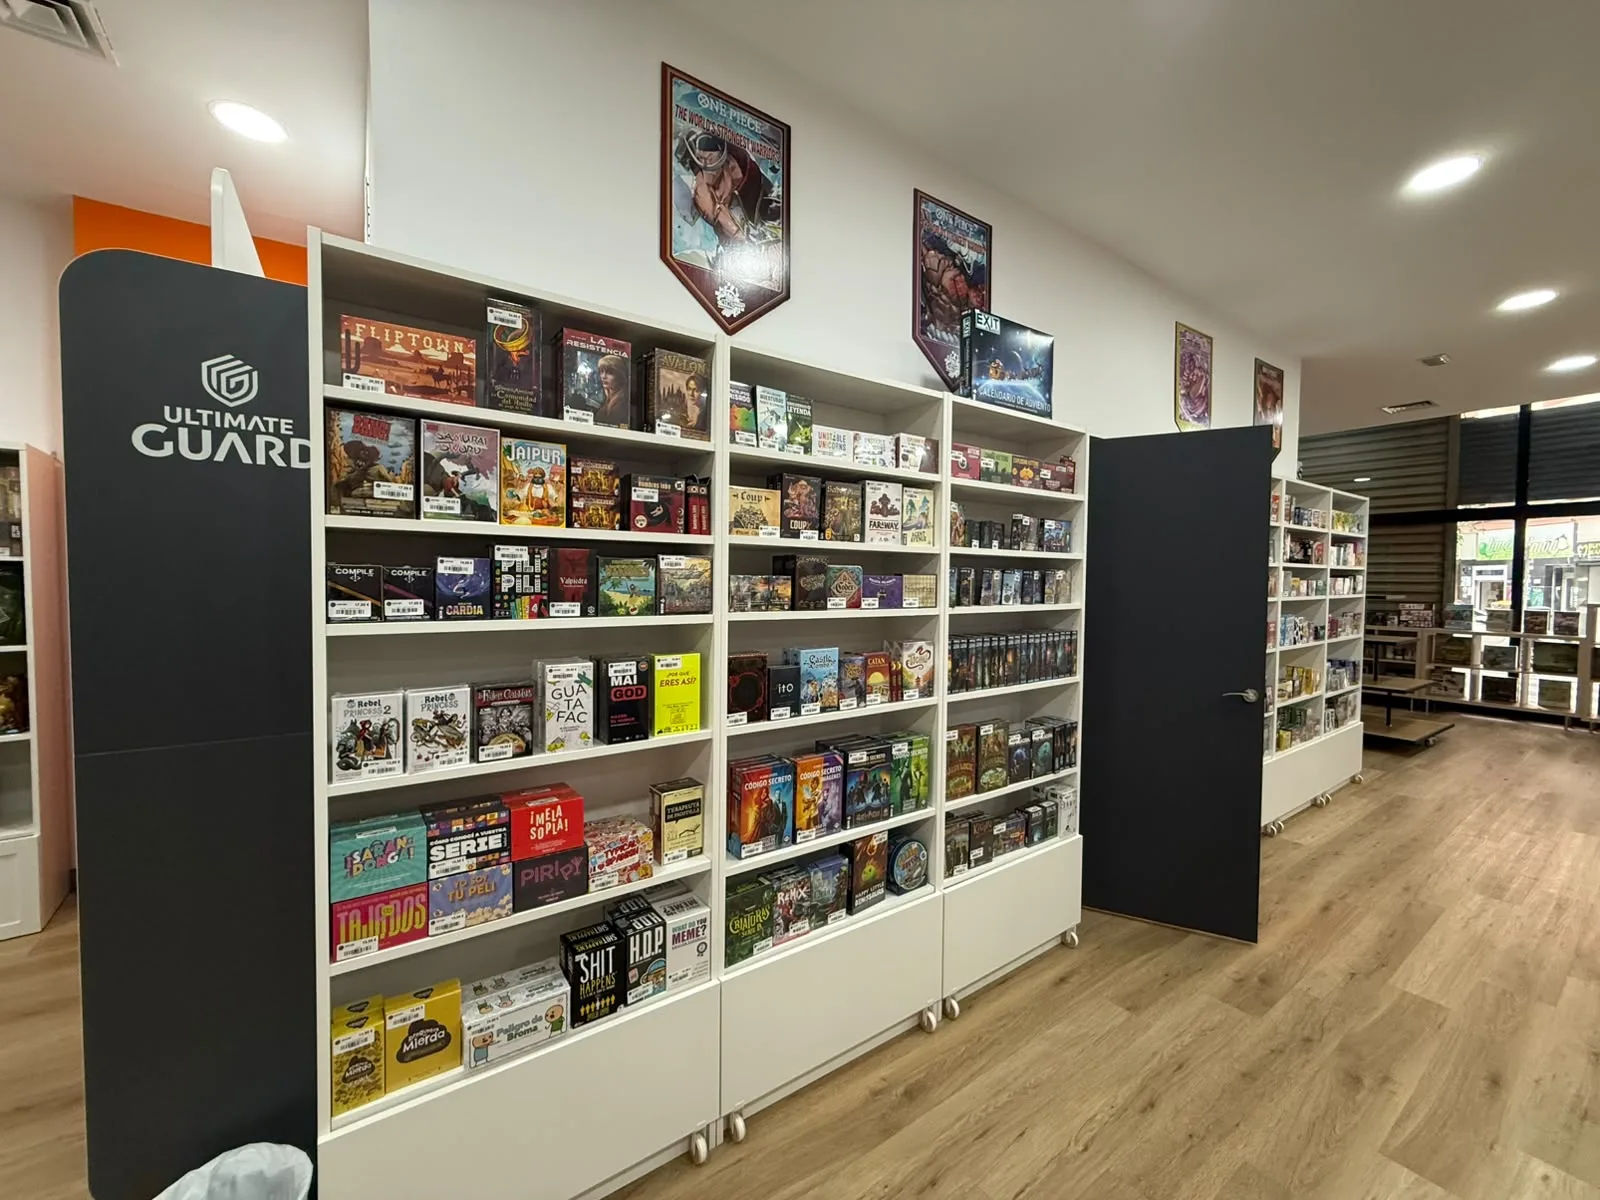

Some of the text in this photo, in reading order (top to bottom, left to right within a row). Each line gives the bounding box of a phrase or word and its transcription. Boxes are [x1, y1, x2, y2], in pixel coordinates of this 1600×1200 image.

[697, 93, 761, 133] ONE PIECE
[675, 104, 687, 121] THE
[717, 123, 748, 149] STRONGEST
[976, 313, 999, 330] EXIT
[355, 323, 464, 353] FLIPTOWN
[590, 336, 606, 346] LA
[566, 339, 629, 358] RESISTENCIA
[662, 354, 706, 374] AVALON
[980, 386, 1015, 403] CALENDARIO
[1016, 396, 1025, 404] DE
[1025, 397, 1051, 413] ADVIENTO
[164, 405, 294, 436] ULTIMATE
[436, 432, 488, 446] SAMURAI
[818, 431, 846, 442] UNSTABLE
[131, 423, 311, 469] GUARD
[507, 443, 562, 466] JAIPUR
[741, 491, 763, 502] Coup
[335, 568, 375, 576] COMPILE
[391, 569, 427, 577] COMPILE
[502, 574, 541, 592] PILI
[446, 605, 484, 615] CARDIA
[531, 603, 538, 613] 4
[868, 657, 885, 665] CATAN
[610, 674, 637, 687] MAI
[660, 678, 681, 688] ERES
[424, 694, 448, 703] Rebel
[551, 684, 587, 700] GUA
[613, 687, 645, 699] GOD
[343, 705, 391, 718] PRINCESS 2
[357, 699, 381, 708] Rebel
[421, 701, 459, 712] PRINCESS
[564, 698, 584, 710] TA
[556, 711, 588, 724] FAC
[800, 765, 842, 780] CÓDIGO SECRETO
[744, 774, 792, 790] CÓDIGO SECRETO
[530, 805, 563, 826] ¡MELA
[530, 819, 568, 840] SOPLA!
[429, 833, 502, 862] SERIE
[455, 875, 489, 888] YO SOY
[448, 882, 495, 901] TU PELI
[336, 893, 426, 944] TAJADOS
[672, 922, 688, 934] WHAT
[696, 917, 707, 926] YOU
[603, 933, 618, 944] SHIT
[671, 925, 707, 946] MEME?
[629, 926, 664, 964] H.D.P.
[579, 945, 616, 984] SHIT
[579, 973, 616, 996] HAPPENS
[496, 1014, 543, 1038] Peligro de
[506, 1024, 539, 1042] Broma
[402, 1029, 446, 1053] Mierda
